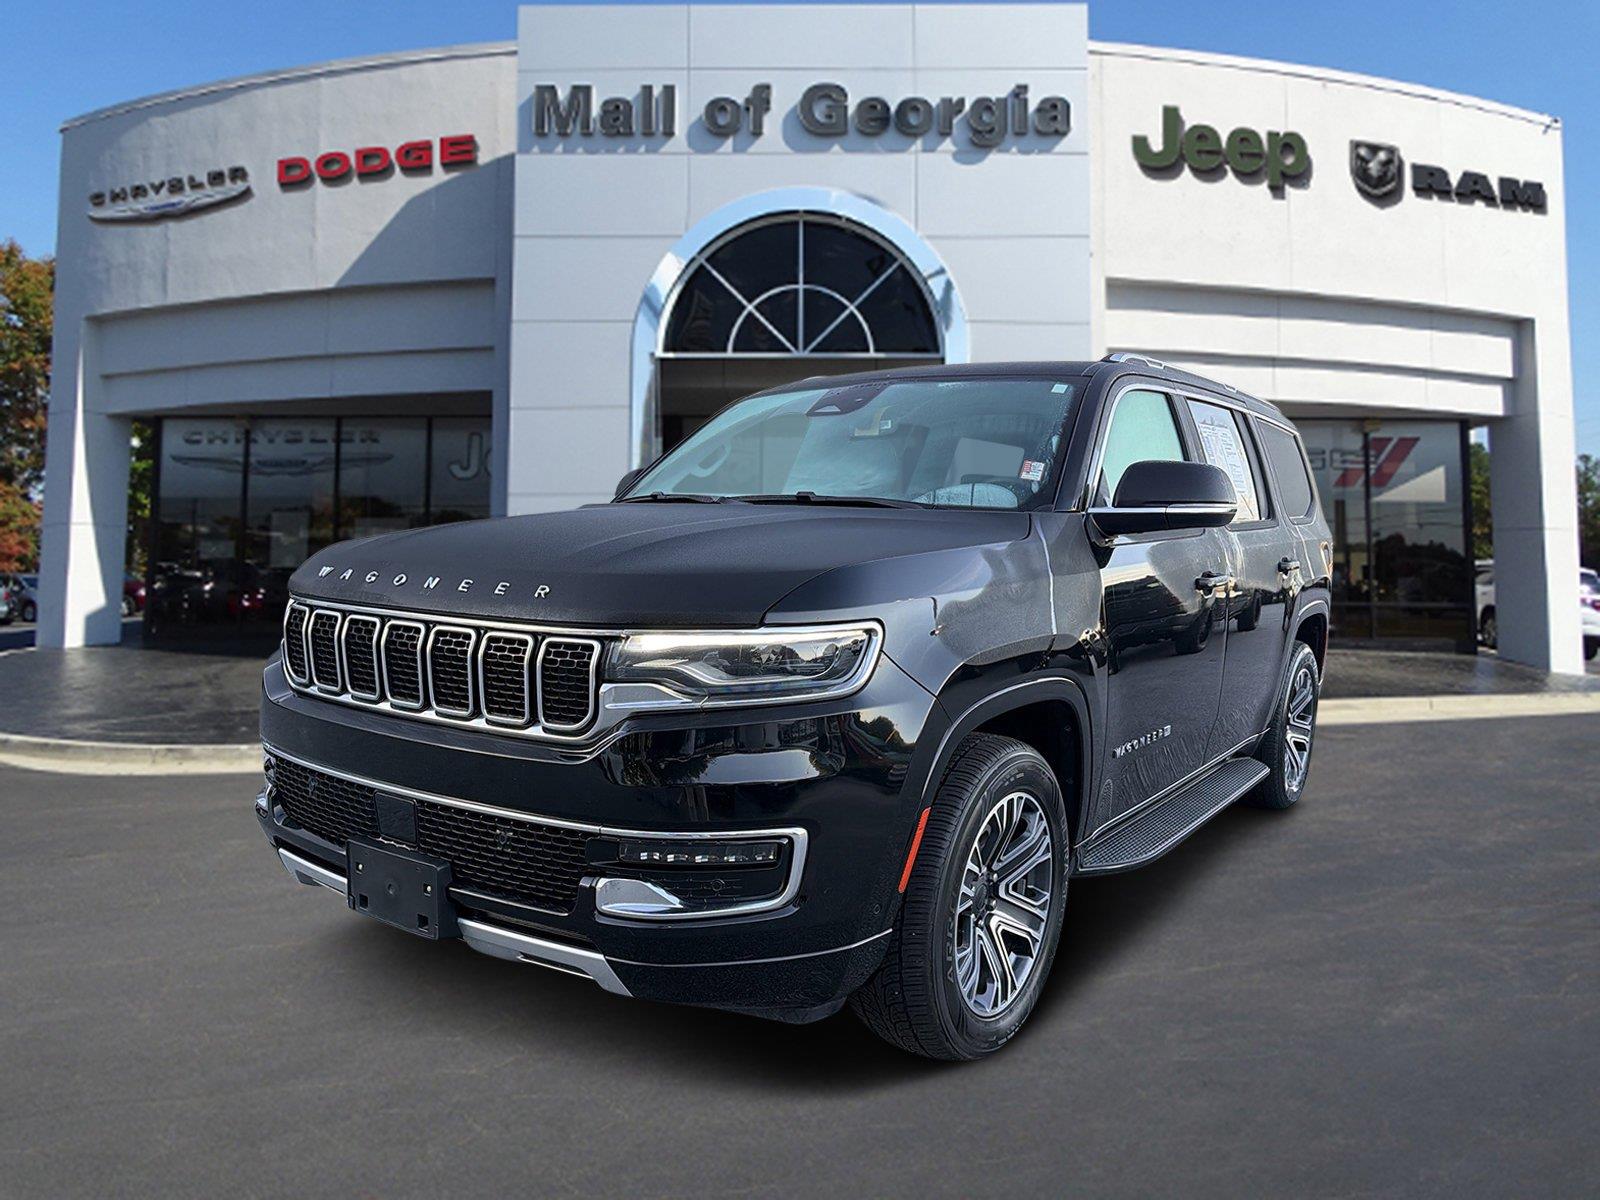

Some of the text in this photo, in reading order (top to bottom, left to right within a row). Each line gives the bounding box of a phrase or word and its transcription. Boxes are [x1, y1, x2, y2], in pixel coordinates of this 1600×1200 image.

[532, 83, 1073, 148] Mall of Georgia
[277, 134, 478, 188] DODGE
[1131, 105, 1309, 188] Jeep
[89, 166, 248, 206] CHRYSLER
[1412, 163, 1547, 212] RAM
[183, 429, 381, 445] CHRYSLER
[318, 566, 552, 599] WAGONEER
